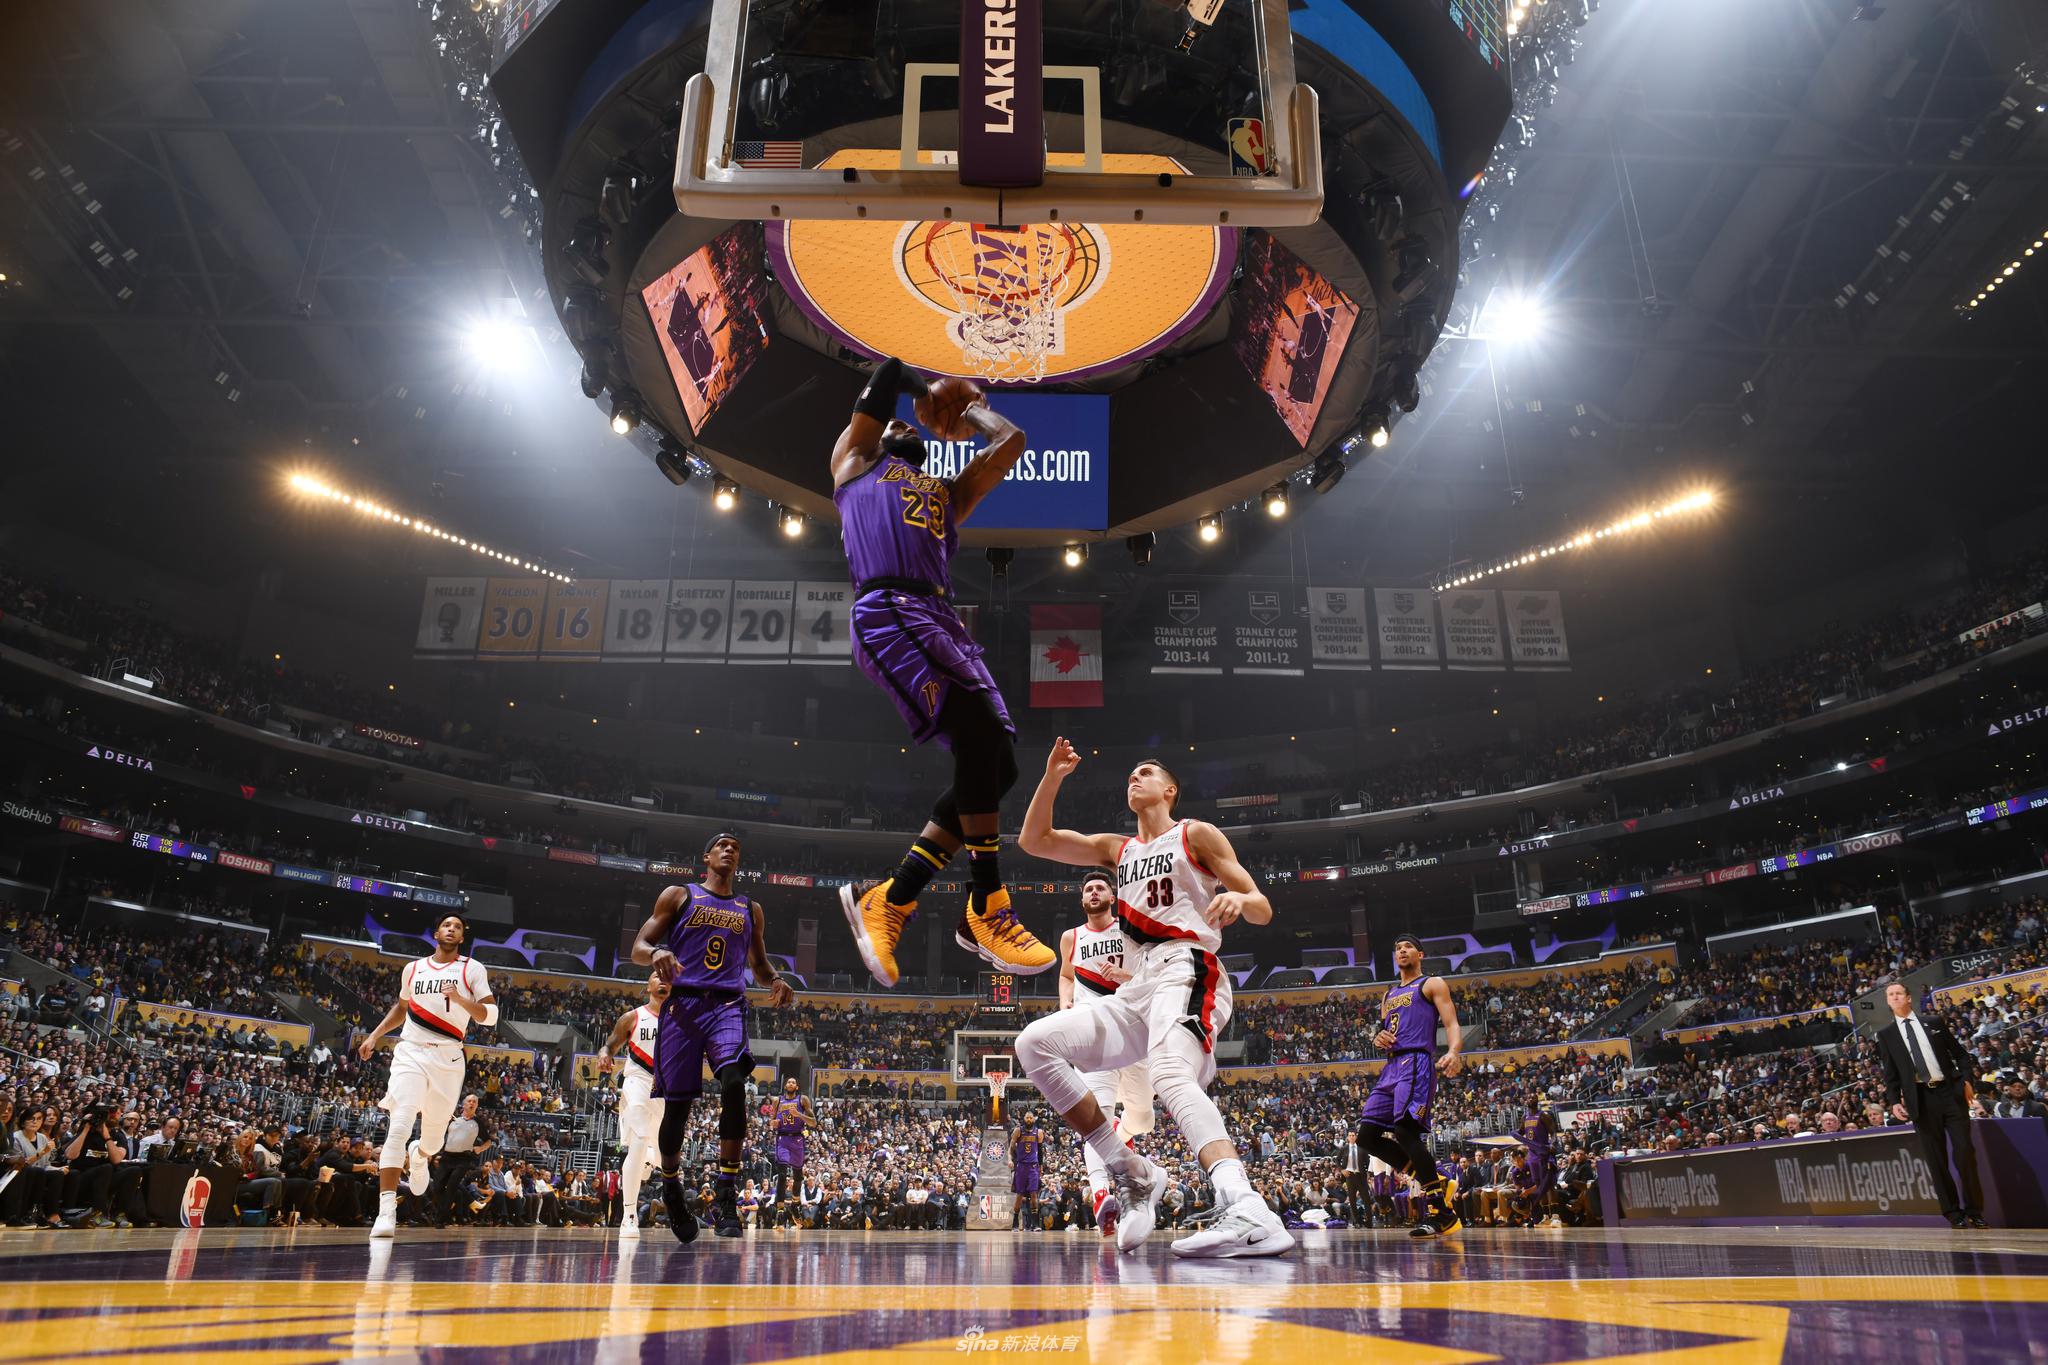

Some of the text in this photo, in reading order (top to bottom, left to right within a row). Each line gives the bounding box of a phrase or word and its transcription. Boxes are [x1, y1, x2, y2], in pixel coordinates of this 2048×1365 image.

[901, 486, 945, 540] 23
[434, 586, 475, 598] MILLER
[619, 589, 659, 600] TAYLOR
[676, 589, 725, 600] GRETZKY
[736, 590, 791, 602] ROBITAILLE
[807, 592, 844, 602] BLAKE
[1171, 593, 1198, 606] LA
[1251, 594, 1278, 606] LA
[488, 607, 534, 639] 30
[555, 607, 590, 639] 16
[616, 608, 653, 641] 18
[675, 608, 723, 641] 99
[737, 610, 785, 642] 20
[1319, 616, 1357, 625] WESTERN
[1387, 617, 1425, 626] WESTERN
[811, 611, 833, 642] 4
[1154, 627, 1217, 637] STANLEY CUP
[1235, 627, 1297, 637] STANLEY CUP
[1314, 625, 1365, 634] CONFERENCE
[1382, 626, 1432, 635] CONFERENCE
[1447, 627, 1497, 636] CONFERENCE
[1154, 636, 1218, 647] CHAMPIONS
[1236, 637, 1298, 649] CHAMPIONS
[1316, 634, 1363, 643] CHAMPIONS
[1386, 635, 1431, 644] CHAMPIONS
[1451, 635, 1495, 644] CHAMPIONS
[1516, 636, 1561, 645] CHAMPIONS
[1324, 645, 1358, 655] 2013-14
[1393, 646, 1425, 656] 2011-12
[1456, 646, 1493, 656] 1992-93
[1522, 647, 1558, 657] 1990-91
[1163, 650, 1210, 663] 2013-14
[1246, 651, 1290, 664] 2011-12
[366, 726, 413, 746] TOYOTA
[104, 750, 153, 771] DELTA
[730, 791, 768, 802] BUD LIGHT
[1742, 787, 1785, 806] DELTA
[2030, 797, 2048, 809] NBA
[2, 801, 53, 825] StubHub
[1965, 806, 1985, 818] MEM
[1996, 808, 2009, 818] 113
[365, 815, 407, 832] DELTA
[1968, 816, 1983, 827] MIL
[133, 832, 150, 842] DET
[160, 838, 173, 847] 106
[1842, 831, 1903, 854] TOYOTA
[132, 839, 148, 849] TOR
[158, 845, 172, 854] 104
[1511, 839, 1549, 853] DELTA
[191, 851, 207, 861] NBA
[1785, 854, 1797, 862] 106
[1816, 852, 1833, 862] NBA
[220, 852, 271, 873] TOSHIBA
[1395, 857, 1437, 871] Spectrum
[1762, 858, 1776, 867] DET
[1786, 861, 1799, 869] 104
[662, 865, 693, 875] TOYOTA
[1118, 852, 1174, 888] BLAZERS
[1351, 863, 1388, 876] StubHub
[1762, 864, 1778, 874] TOR
[282, 868, 322, 882] BUD LIGHT
[337, 874, 351, 883] CHI
[1265, 871, 1292, 880] LAL POR
[336, 881, 351, 890] BOS
[1042, 884, 1054, 893] 28
[393, 890, 407, 899] NBA
[1146, 877, 1174, 908] 33
[1576, 893, 1588, 902] CHI
[1630, 890, 1645, 899] NBA
[427, 893, 462, 906] DELTA
[1576, 900, 1590, 908] BOS
[1523, 898, 1569, 914] STAPLES
[684, 905, 745, 934] LAKERS
[717, 910, 745, 919] ANGELES
[704, 935, 727, 970] 9
[1080, 938, 1123, 961] BLAZERS
[993, 986, 1011, 1004] 19
[444, 996, 450, 1012] 1
[1390, 1012, 1400, 1034] 3
[782, 1113, 795, 1126] 14
[1630, 1167, 1720, 1215] NBA League Pass
